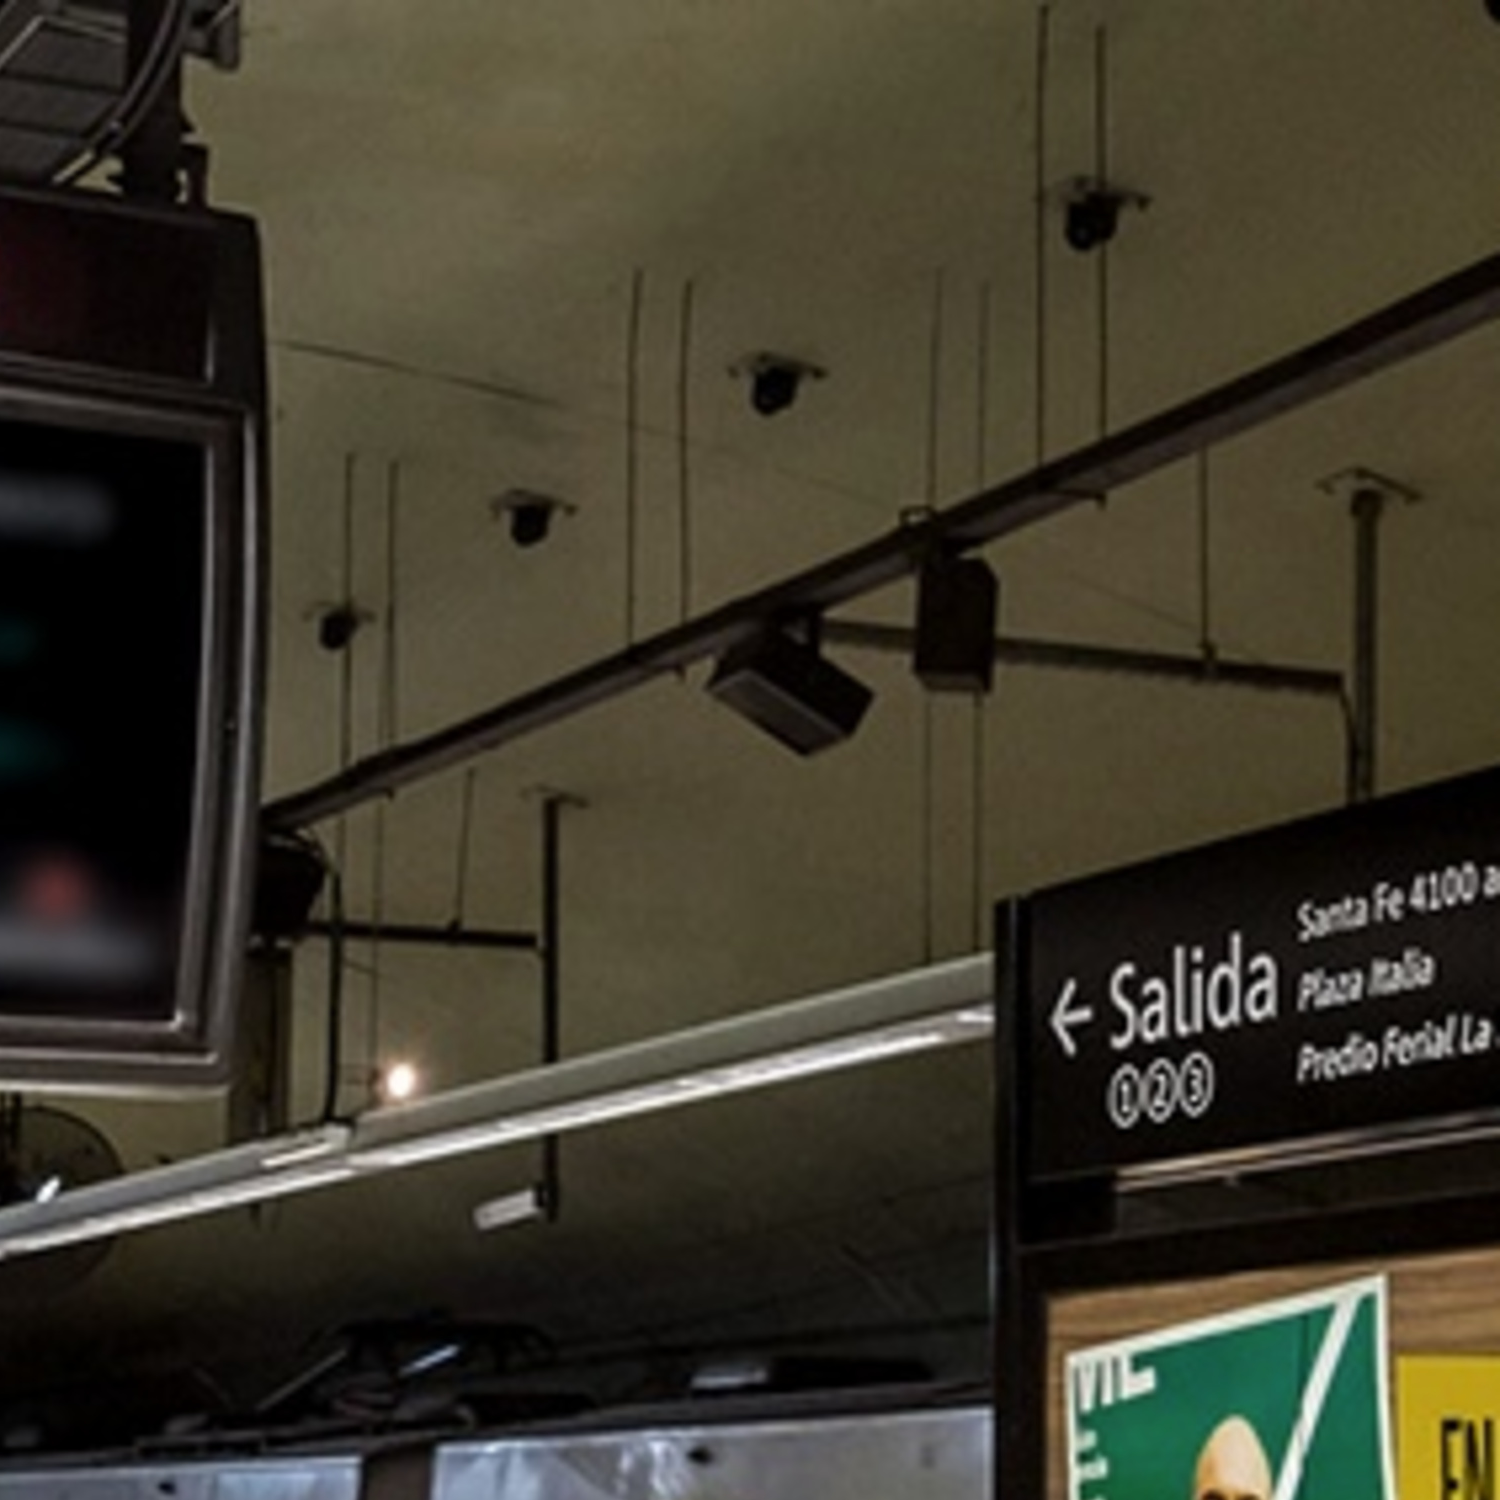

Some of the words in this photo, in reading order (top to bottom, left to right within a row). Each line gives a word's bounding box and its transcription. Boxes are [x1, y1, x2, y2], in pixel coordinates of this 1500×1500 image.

[1297, 897, 1368, 943] Santa
[1373, 881, 1406, 923] Fe
[1409, 860, 1480, 912] 4100
[1108, 931, 1278, 1050] Salida
[1297, 967, 1364, 1012] Plaza
[1367, 946, 1435, 998] Italia
[1297, 1031, 1379, 1083] Predio
[1382, 1013, 1458, 1070] Ferial
[1461, 1013, 1492, 1054] La
